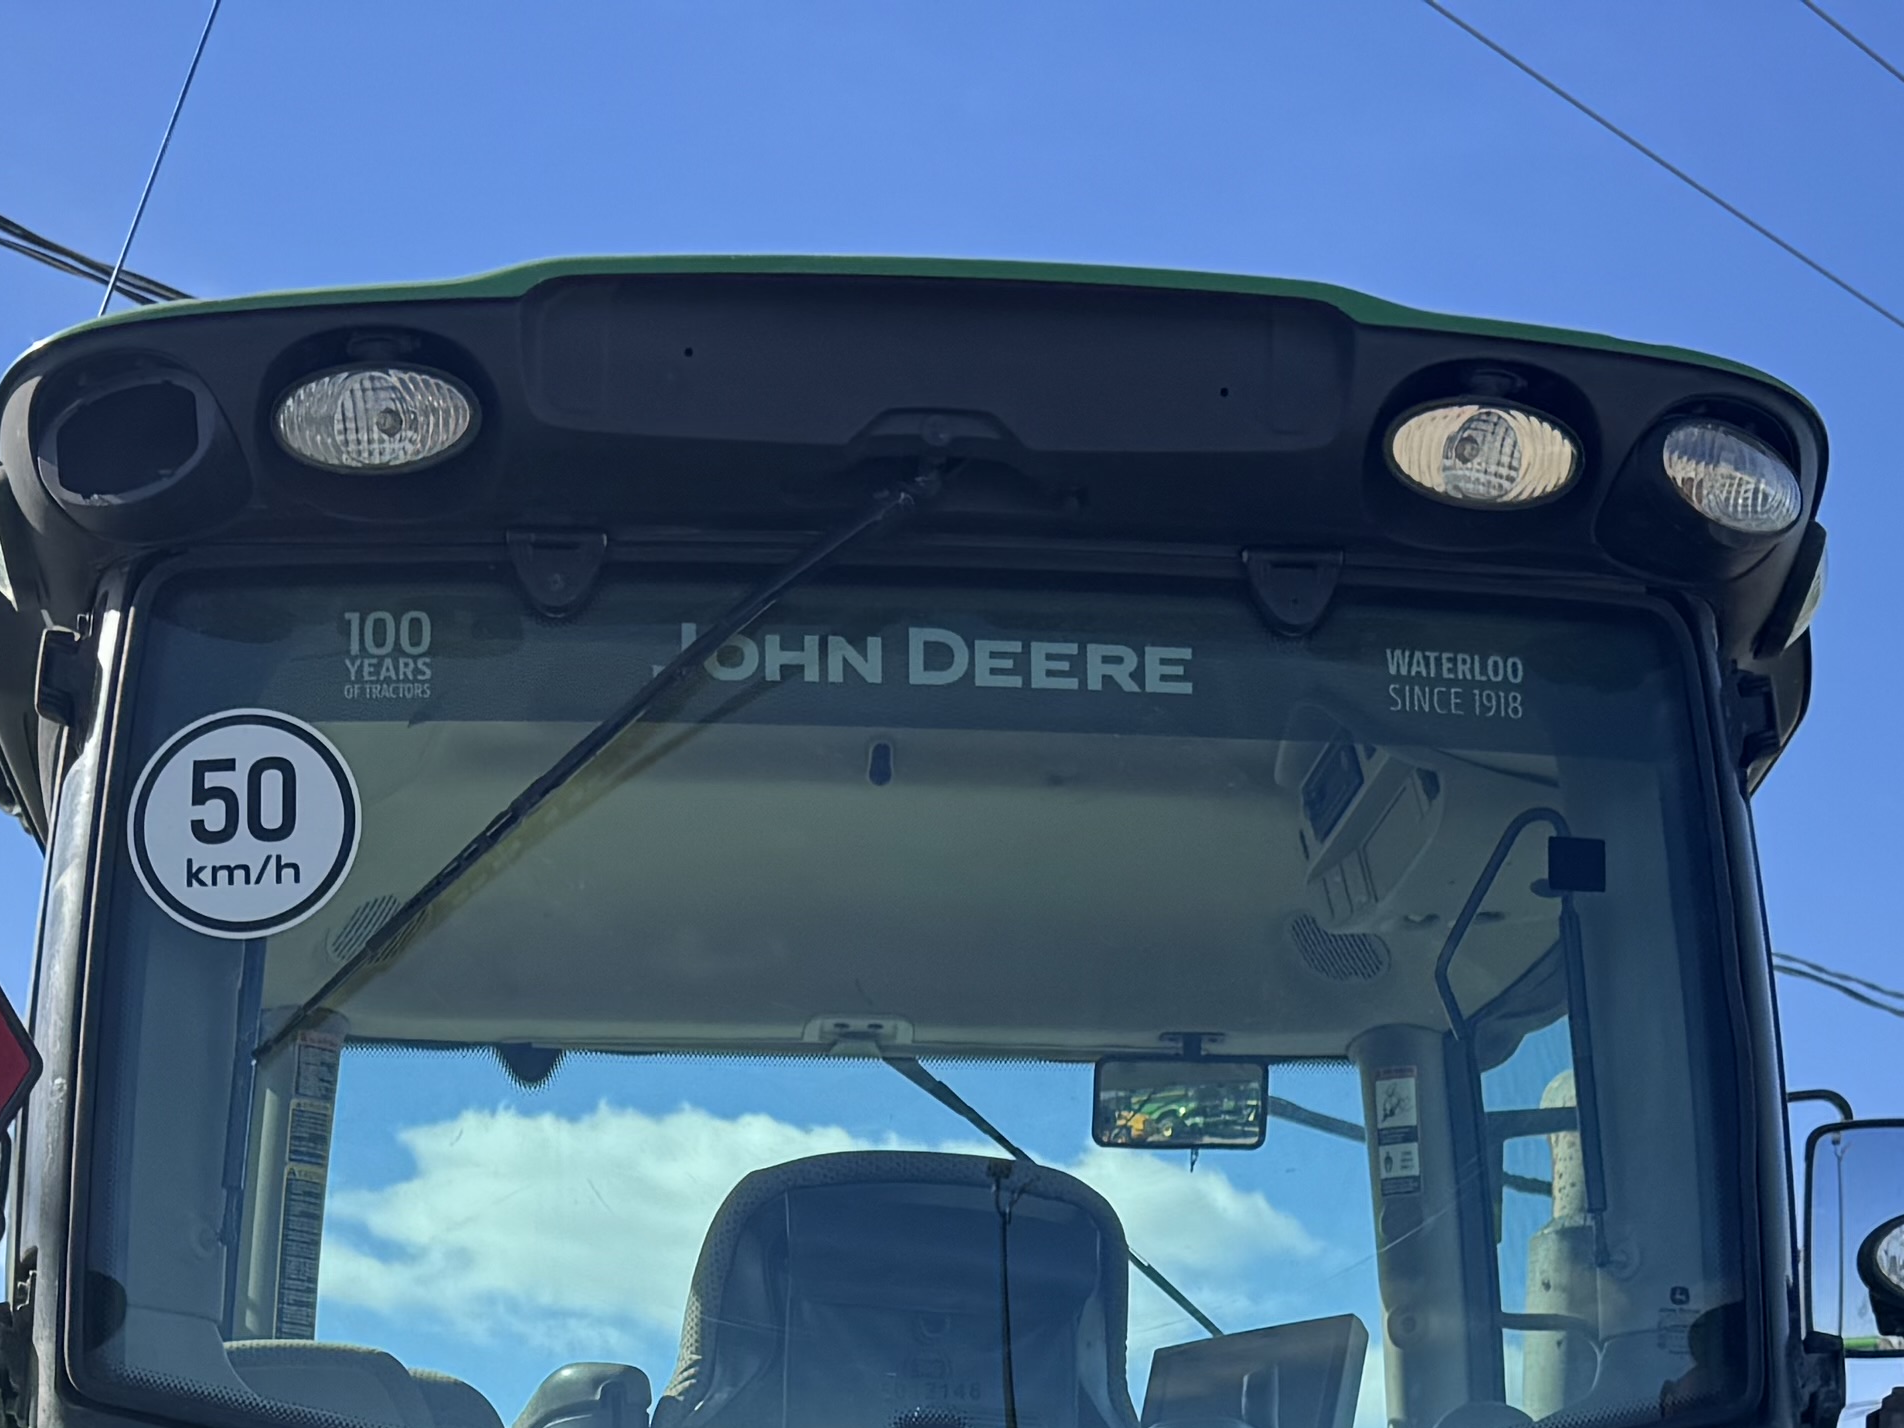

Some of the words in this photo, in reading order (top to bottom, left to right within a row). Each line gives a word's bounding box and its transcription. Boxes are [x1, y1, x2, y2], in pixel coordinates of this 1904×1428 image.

[344, 610, 432, 656] 100
[344, 657, 432, 681] YEARS
[908, 626, 1193, 694] DEERE
[1386, 648, 1523, 683] WATERLOO
[344, 684, 361, 699] OF
[364, 683, 431, 699] TRACTORS
[1388, 684, 1464, 715] SINCE
[1472, 689, 1523, 719] 1918
[190, 756, 297, 845] 50
[186, 854, 301, 888] km/h
